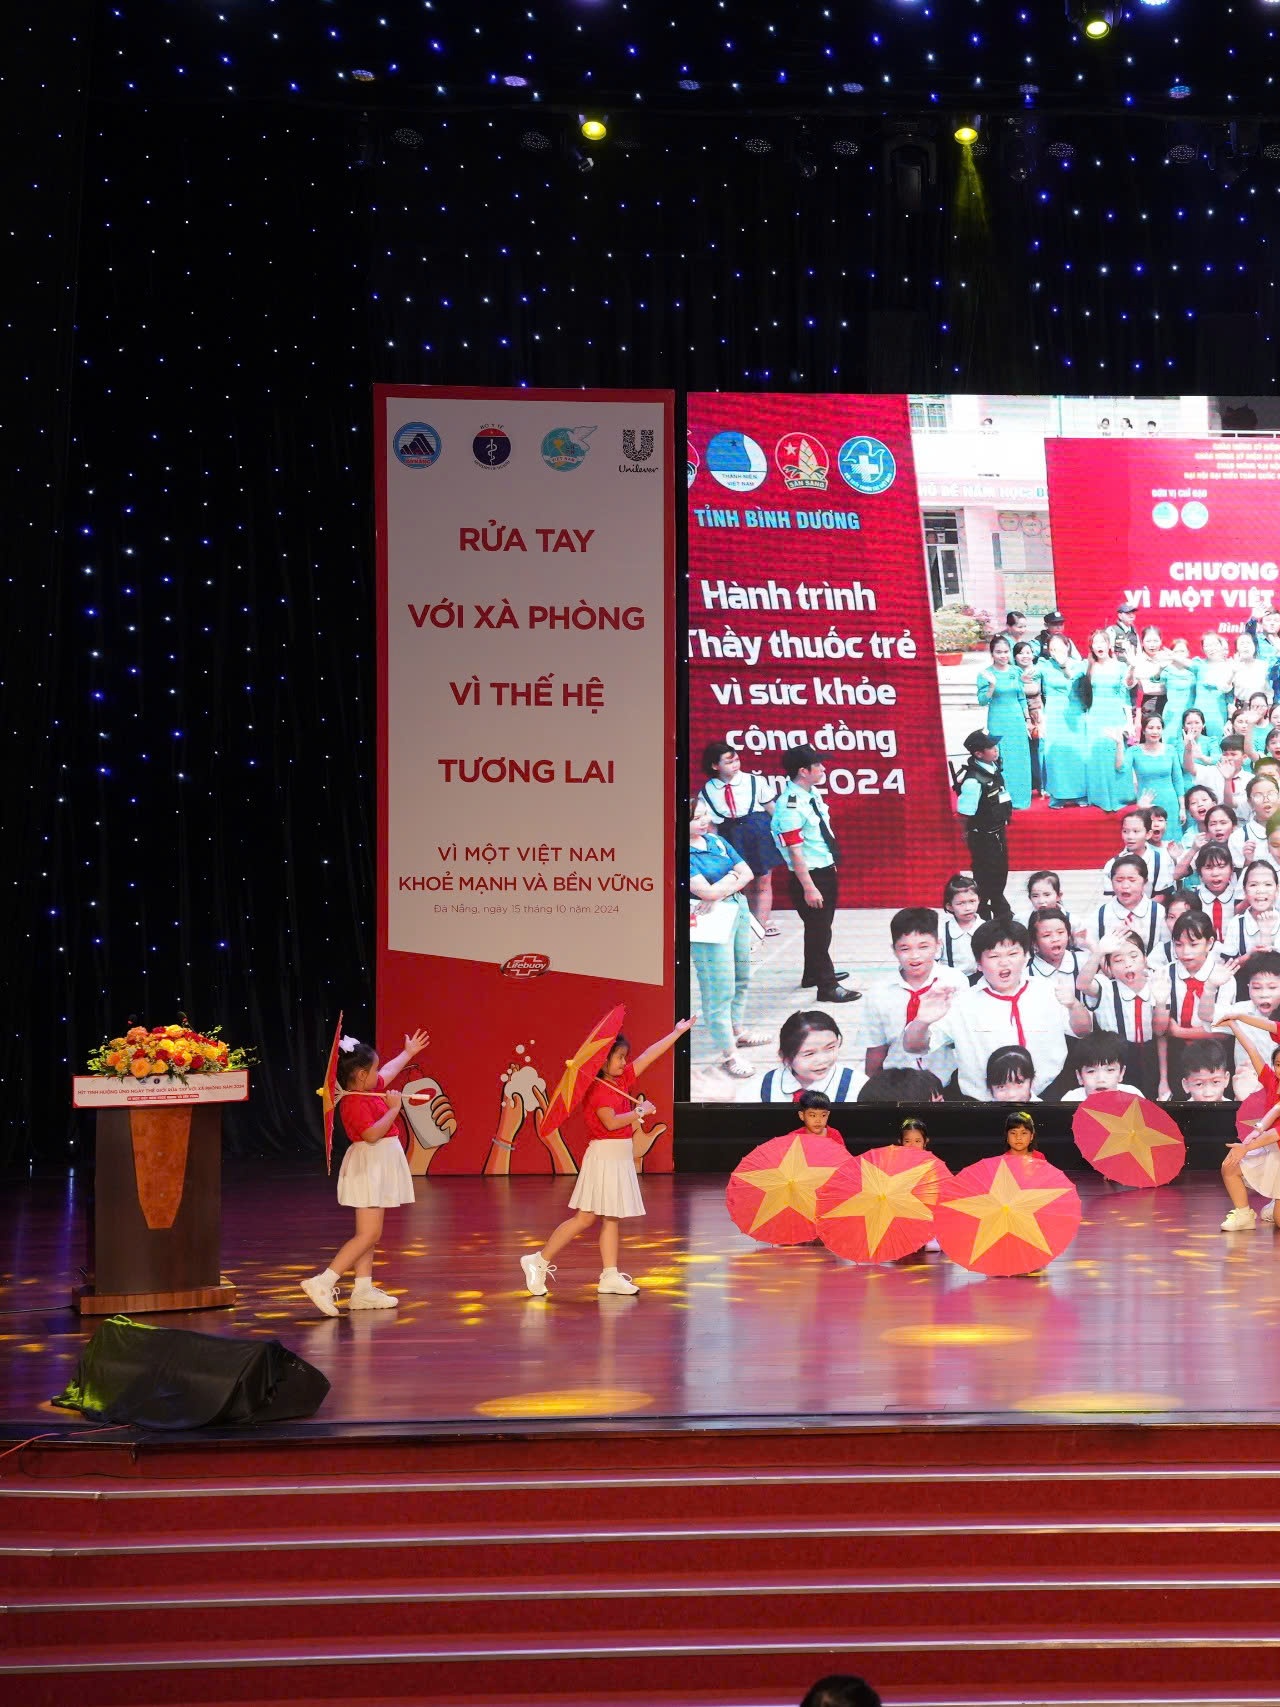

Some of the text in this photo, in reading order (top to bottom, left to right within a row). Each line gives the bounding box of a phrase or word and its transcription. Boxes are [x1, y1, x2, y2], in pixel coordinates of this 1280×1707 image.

[618, 464, 659, 473] Unilever
[694, 504, 861, 530] TỈNH BÌNH DƯƠNG
[459, 519, 596, 553] RỬA TAY
[1169, 561, 1279, 581] CHƯƠNG
[700, 580, 877, 611] Hành trình
[1124, 586, 1151, 608] VÌ
[1159, 586, 1215, 612] MỘT
[407, 597, 645, 630] VỚI XÀ PHÒNG
[689, 625, 917, 666] Thầy thuốc trẻ
[449, 673, 605, 714] VÌ THẾ HỆ
[710, 676, 897, 706] vì sức khỏe
[814, 720, 898, 759] đồng
[438, 757, 615, 784] TƯƠNG LAI
[438, 843, 616, 866] VÌ MỘT VIỆT NAM
[399, 871, 654, 895] KHOẺ MẠNH VÀ BỀN VỮNG
[484, 905, 508, 915] ngày
[512, 905, 521, 914] 15
[524, 905, 553, 915] tháng
[556, 905, 567, 914] 10
[569, 905, 591, 914] năm
[594, 905, 620, 914] 2024
[506, 961, 547, 970] Lifebuoy
